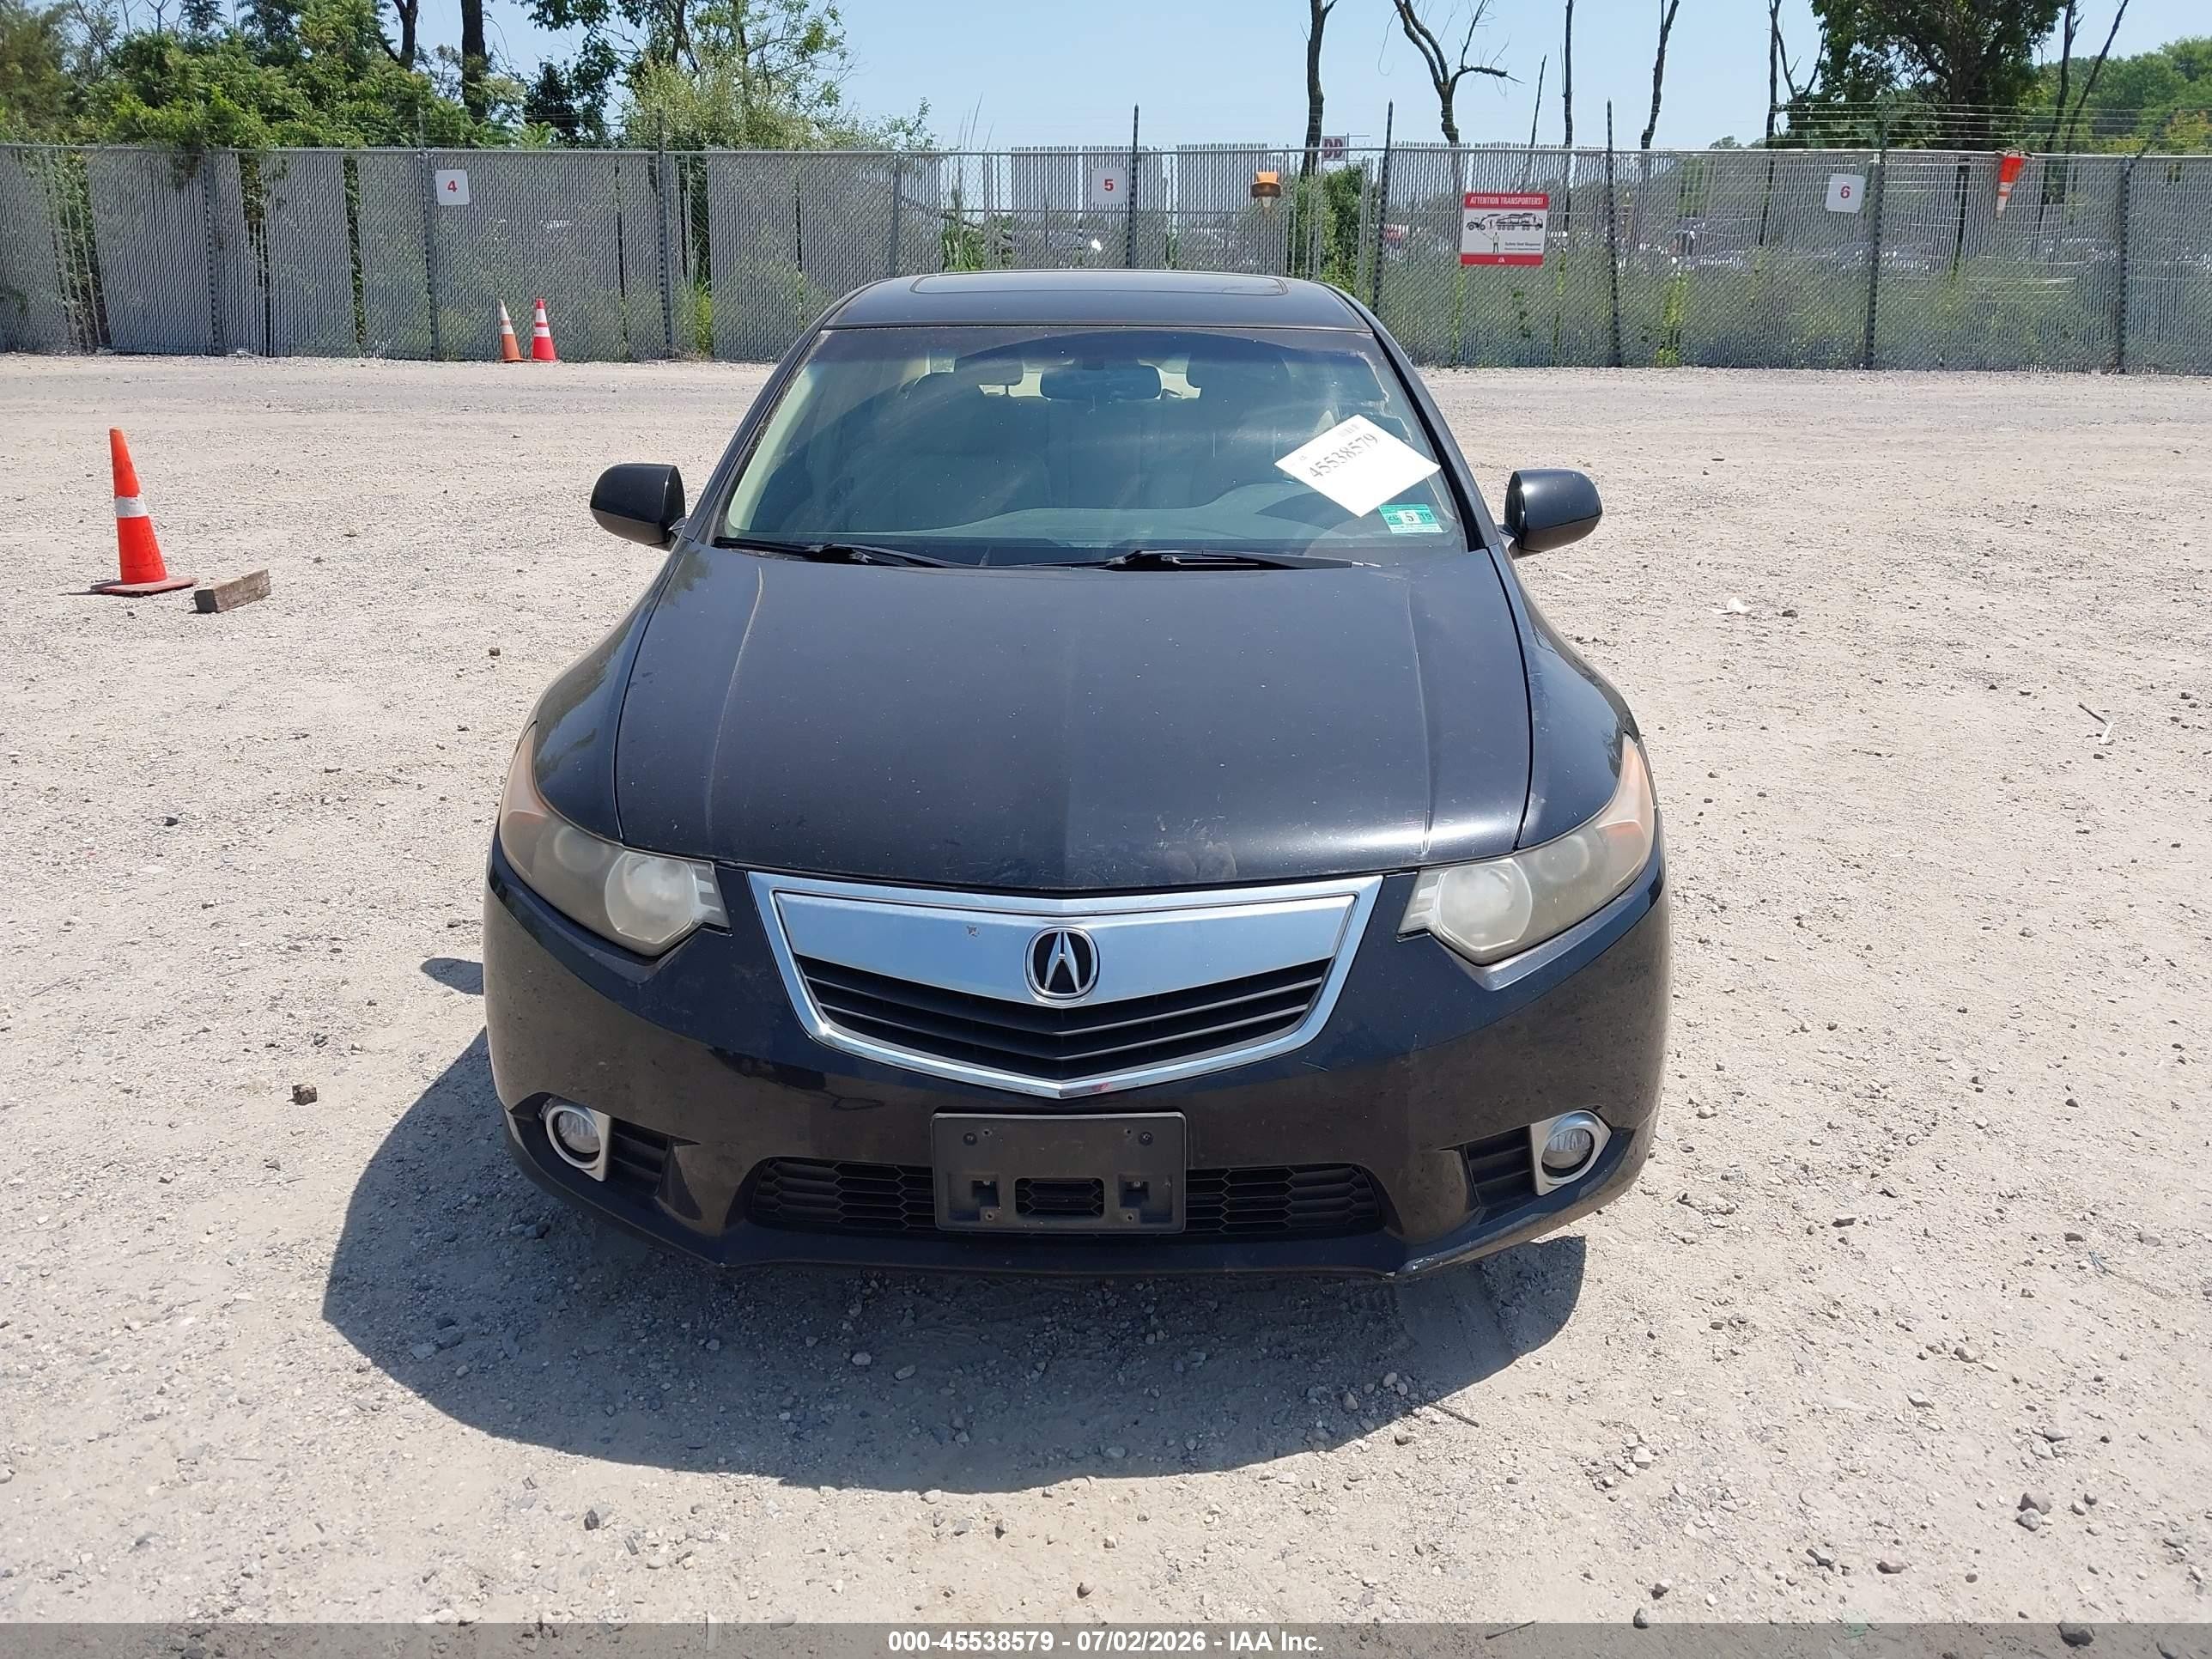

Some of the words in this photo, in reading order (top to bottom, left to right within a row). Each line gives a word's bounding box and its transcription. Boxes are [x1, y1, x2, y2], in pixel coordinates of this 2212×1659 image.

[447, 180, 458, 192] 4
[1104, 179, 1114, 191] 5
[1840, 185, 1850, 198] 6
[1470, 196, 1499, 205] ATTENTION
[1500, 197, 1544, 205] TRANSPORTERS!
[1310, 433, 1378, 477] 45538579
[1405, 512, 1414, 522] 5
